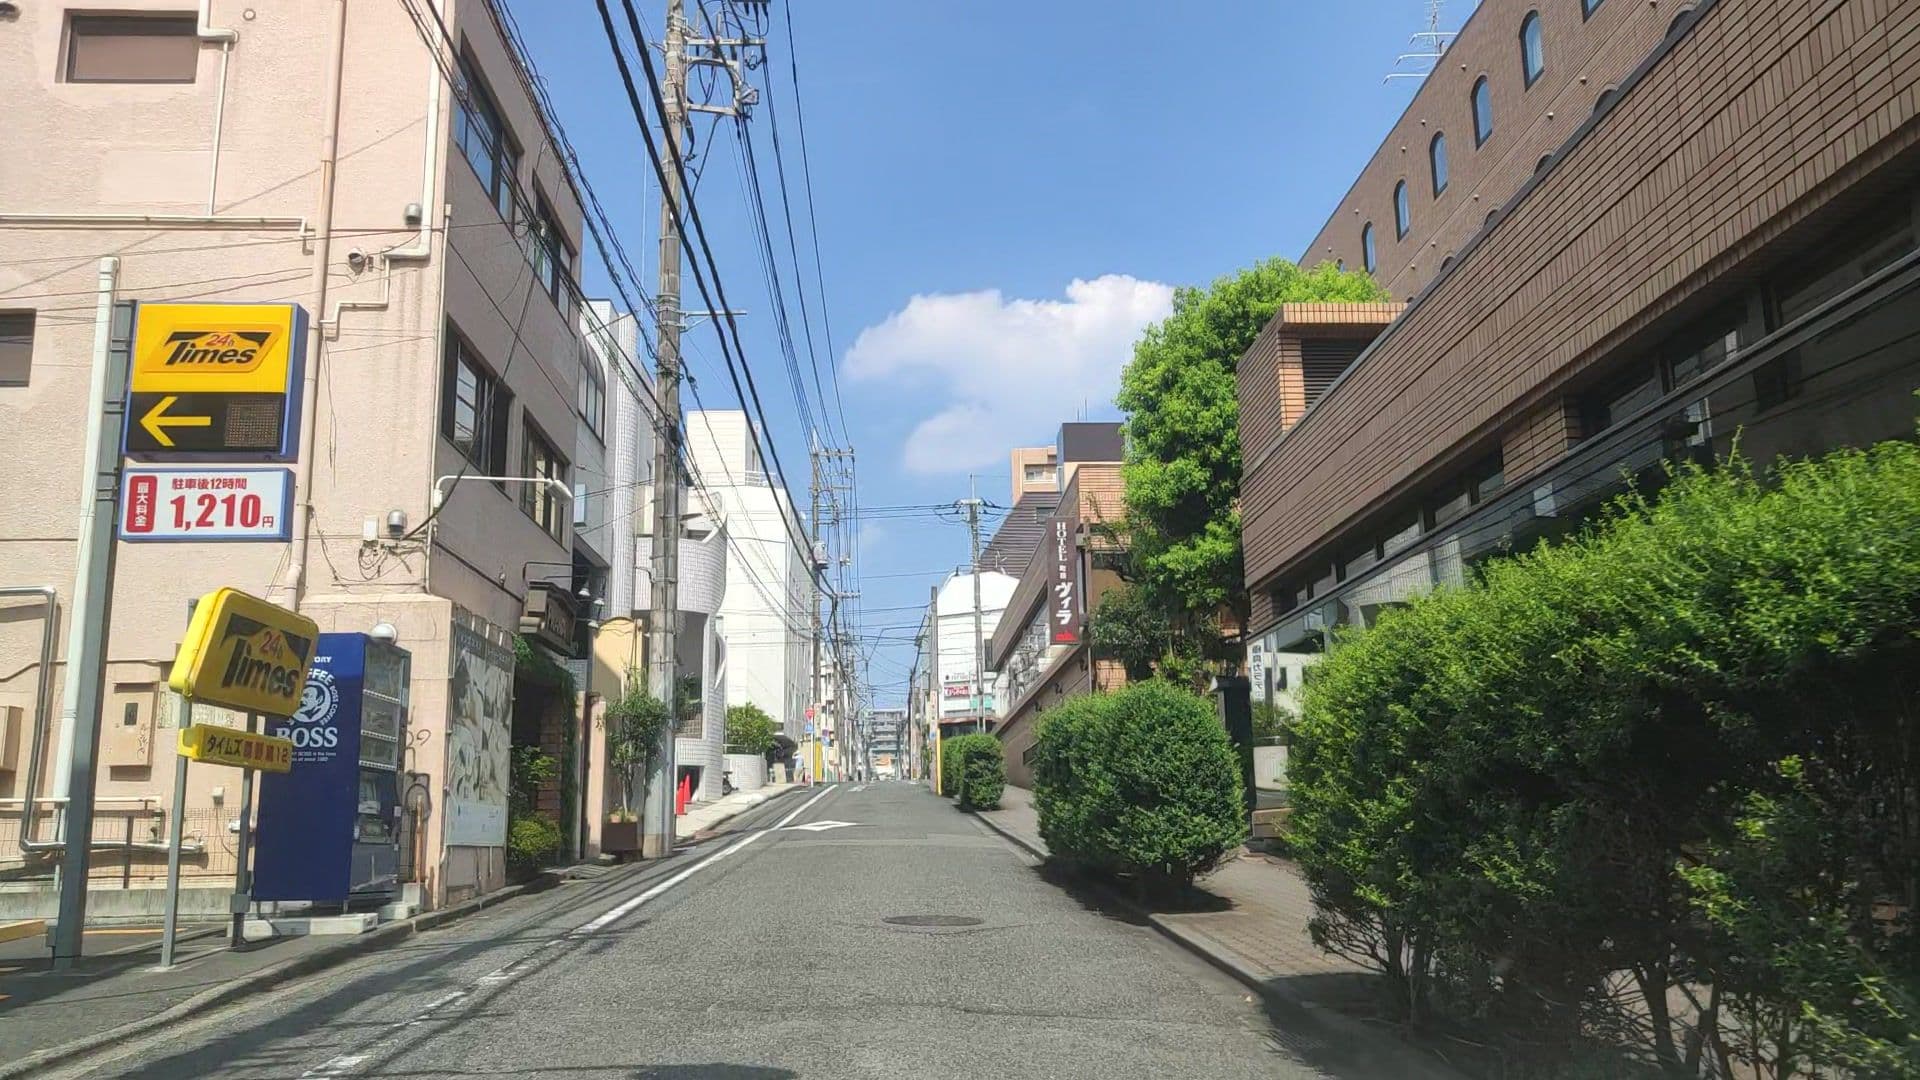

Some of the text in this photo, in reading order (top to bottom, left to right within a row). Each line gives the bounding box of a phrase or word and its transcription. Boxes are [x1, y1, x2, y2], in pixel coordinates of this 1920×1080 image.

[164, 340, 257, 366] Times
[172, 478, 247, 490] 駐車後12時間
[135, 482, 149, 527] 最大料金
[1056, 522, 1067, 561] HOTEL
[221, 637, 299, 698] Times
[276, 726, 338, 748] BOSS
